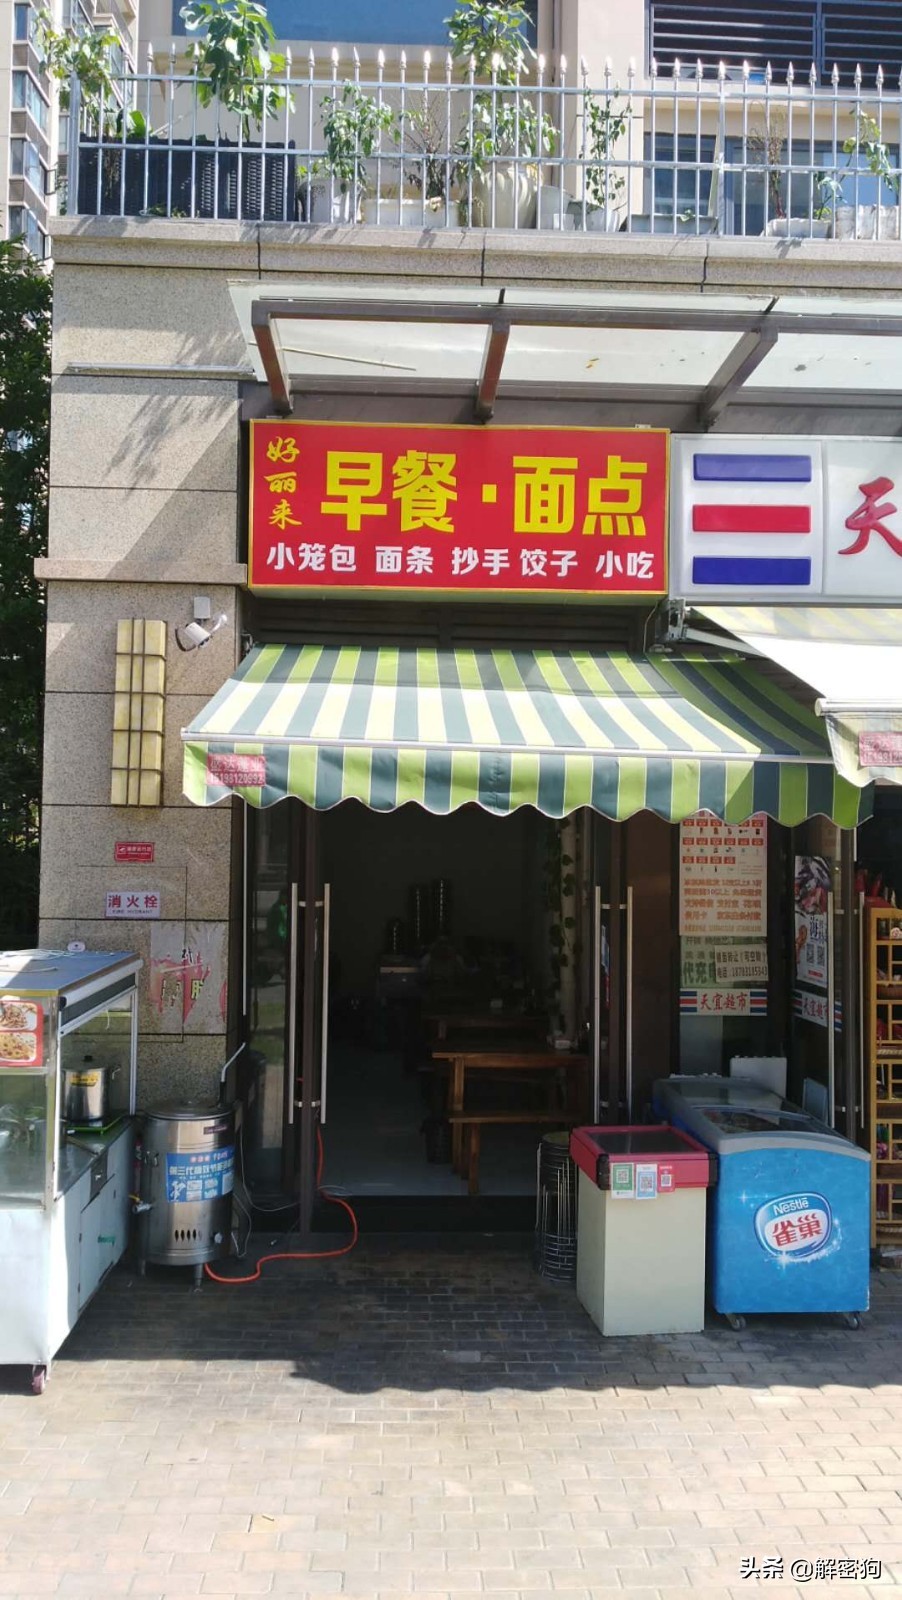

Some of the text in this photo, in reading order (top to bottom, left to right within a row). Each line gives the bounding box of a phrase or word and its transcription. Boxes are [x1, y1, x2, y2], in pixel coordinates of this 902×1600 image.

[263, 436, 302, 531] 好丽来
[837, 477, 902, 559] 天
[266, 542, 655, 580] 小笼包 面条 抄手 饺子 小吃
[107, 894, 158, 908] 消火栓
[699, 991, 748, 1012] 天宜超市
[772, 1213, 823, 1247] 雀巢
